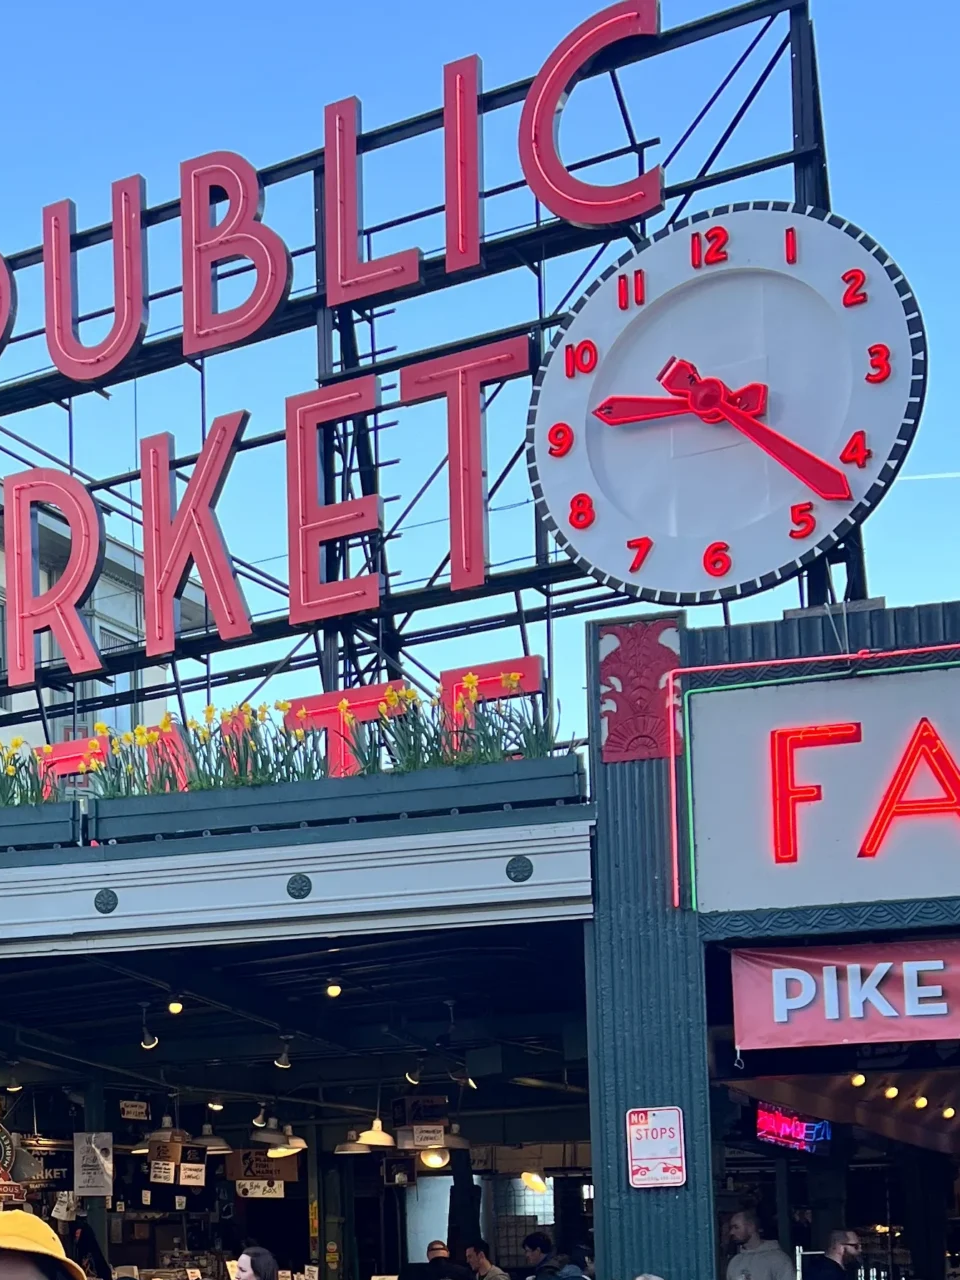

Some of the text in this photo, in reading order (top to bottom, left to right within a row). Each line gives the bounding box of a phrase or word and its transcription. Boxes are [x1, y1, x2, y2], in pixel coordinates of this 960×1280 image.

[690, 226, 729, 269] 12
[784, 226, 797, 264] 1
[618, 269, 645, 310] 11
[841, 268, 868, 307] 2
[564, 339, 598, 378] 10
[865, 343, 892, 384] 3
[547, 422, 574, 458] 9
[839, 430, 873, 469] 4
[568, 493, 596, 530] 8
[788, 501, 817, 539] 5
[626, 536, 654, 573] 7
[702, 541, 732, 578] 6
[771, 959, 949, 1023] PIKE
[631, 1112, 646, 1124] NO
[636, 1127, 675, 1141] STOPS
[0, 1134, 12, 1168] MARKET
